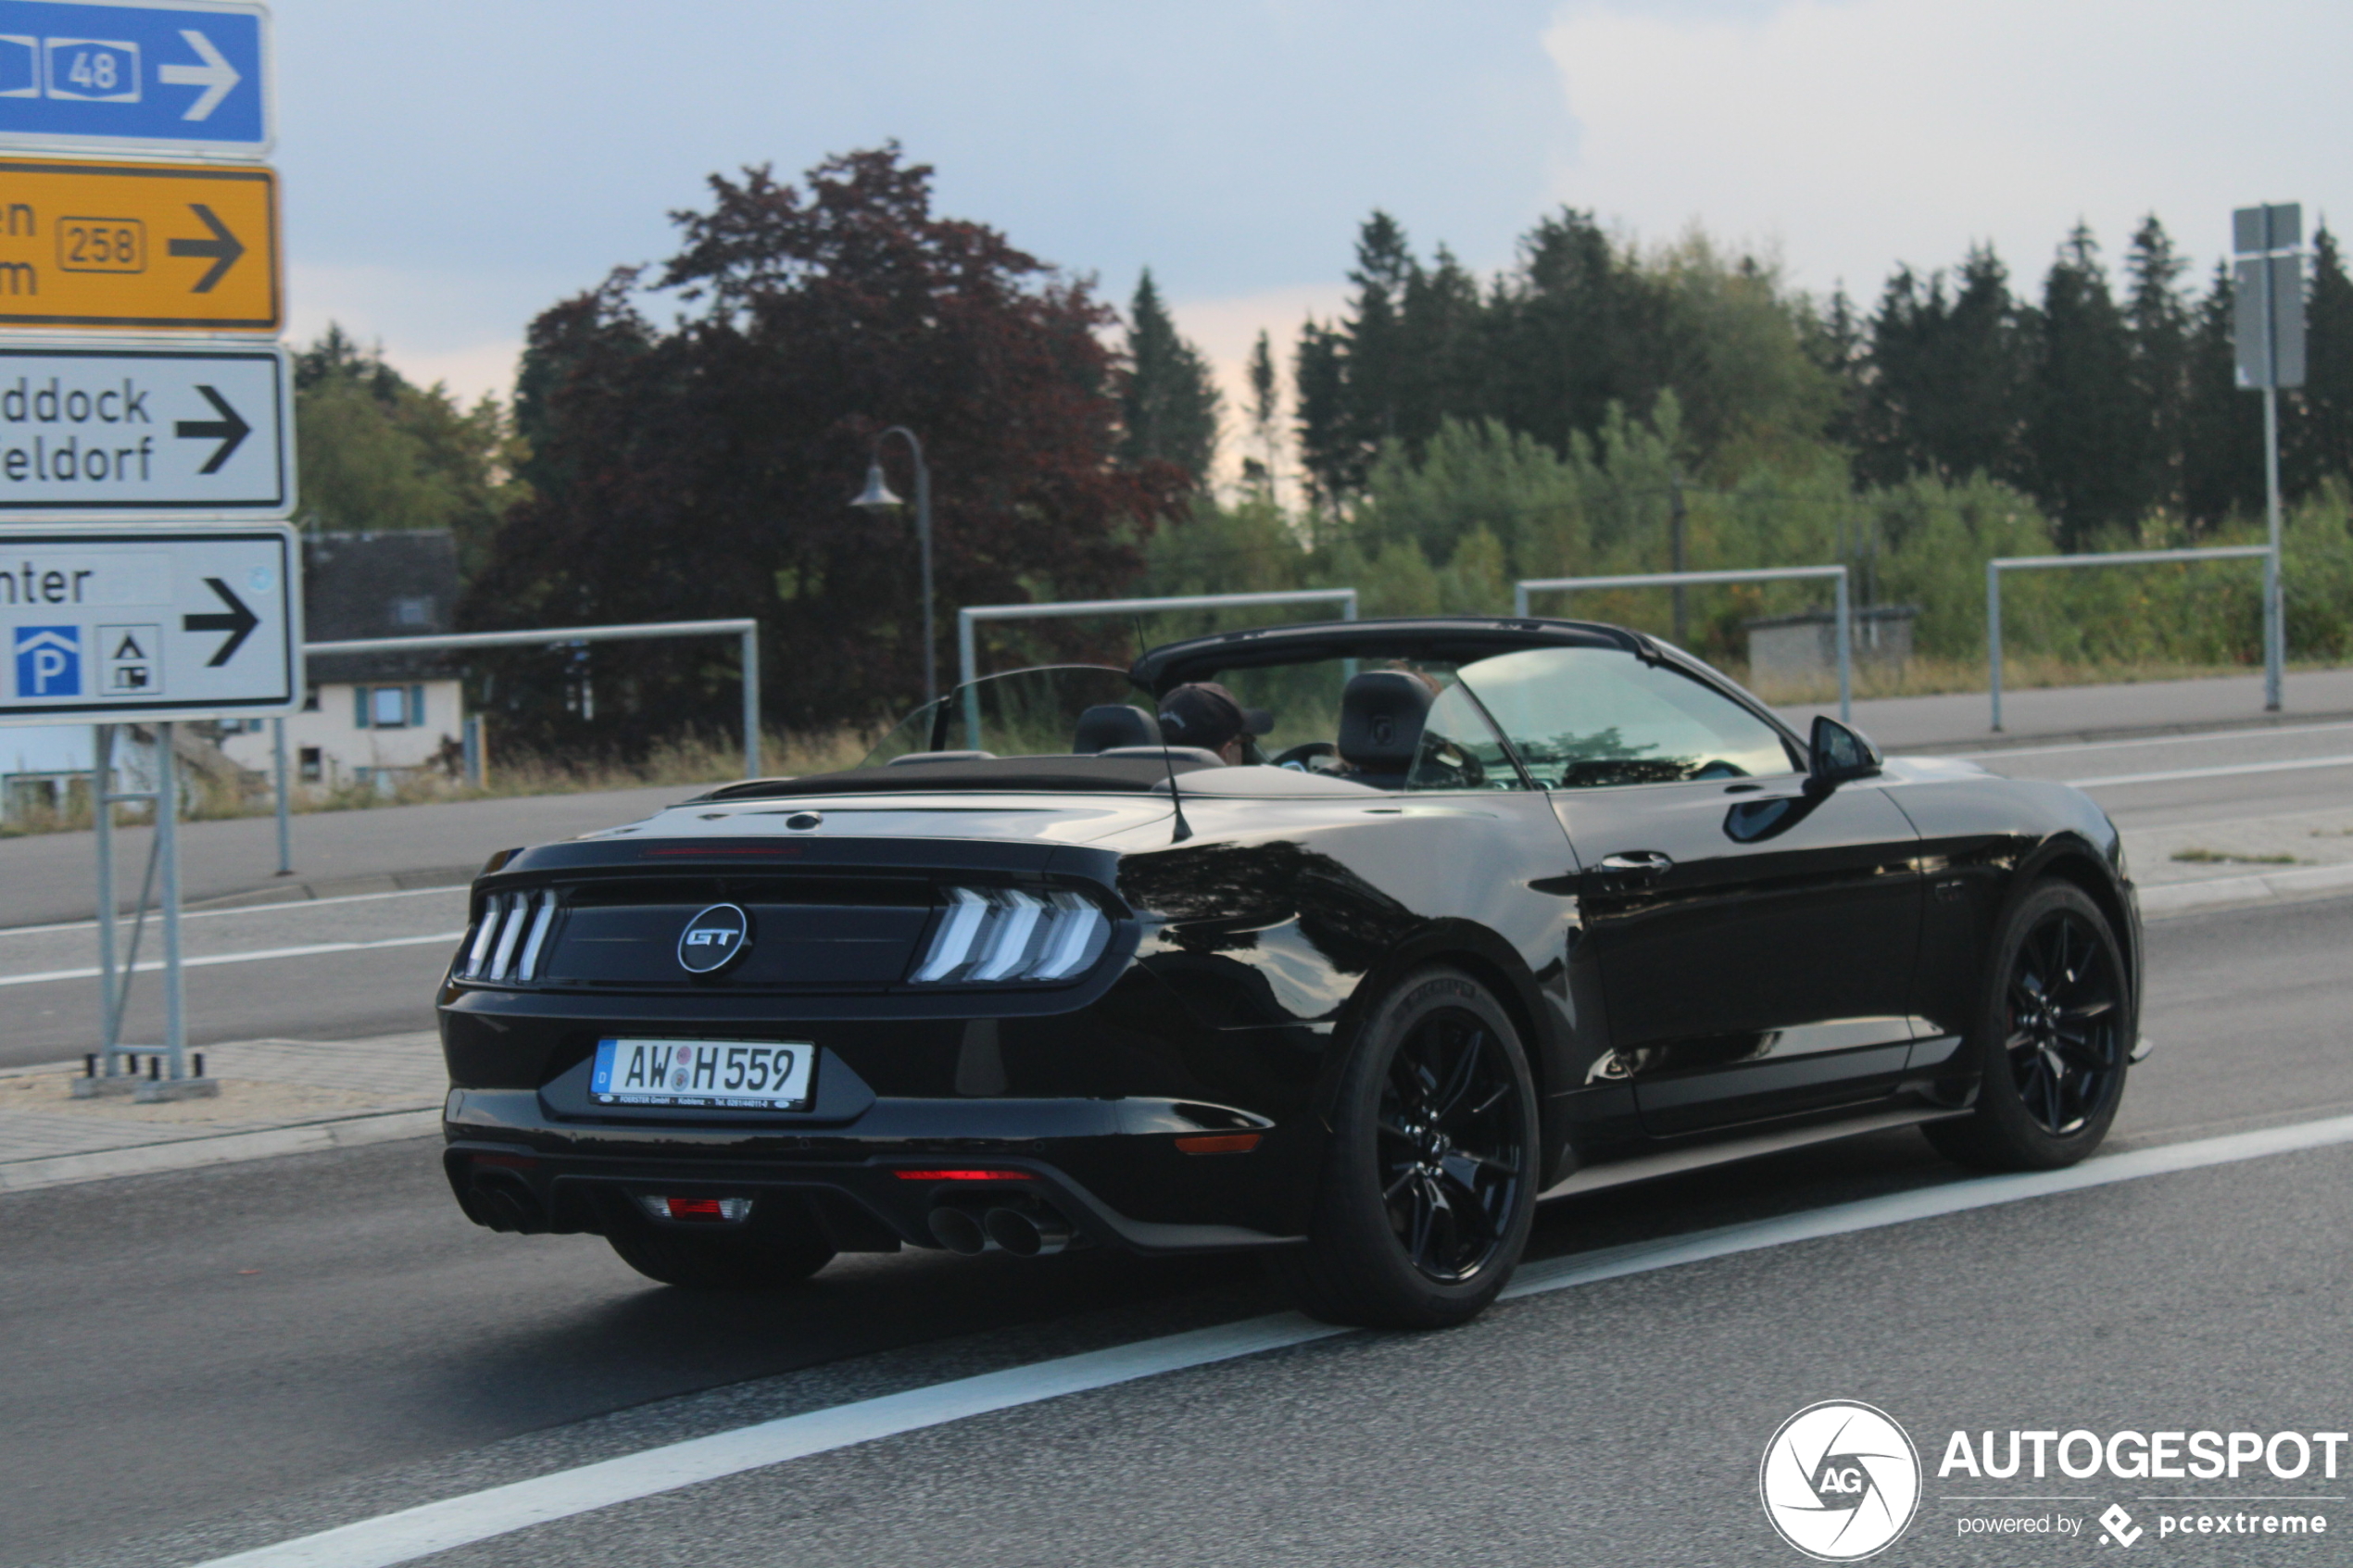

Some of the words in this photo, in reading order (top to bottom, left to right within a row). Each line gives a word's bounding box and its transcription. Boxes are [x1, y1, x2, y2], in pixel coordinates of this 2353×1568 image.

[69, 52, 118, 89] 48
[0, 203, 35, 236] n
[68, 228, 136, 263] 258
[3, 377, 151, 423] ddock
[33, 650, 66, 694] P
[686, 928, 739, 946] GT
[598, 1072, 607, 1085] D
[624, 1046, 673, 1087] AW
[692, 1047, 719, 1090] H
[724, 1047, 795, 1092] 559
[650, 1097, 670, 1105] GmbH
[678, 1098, 705, 1106] Koblenz
